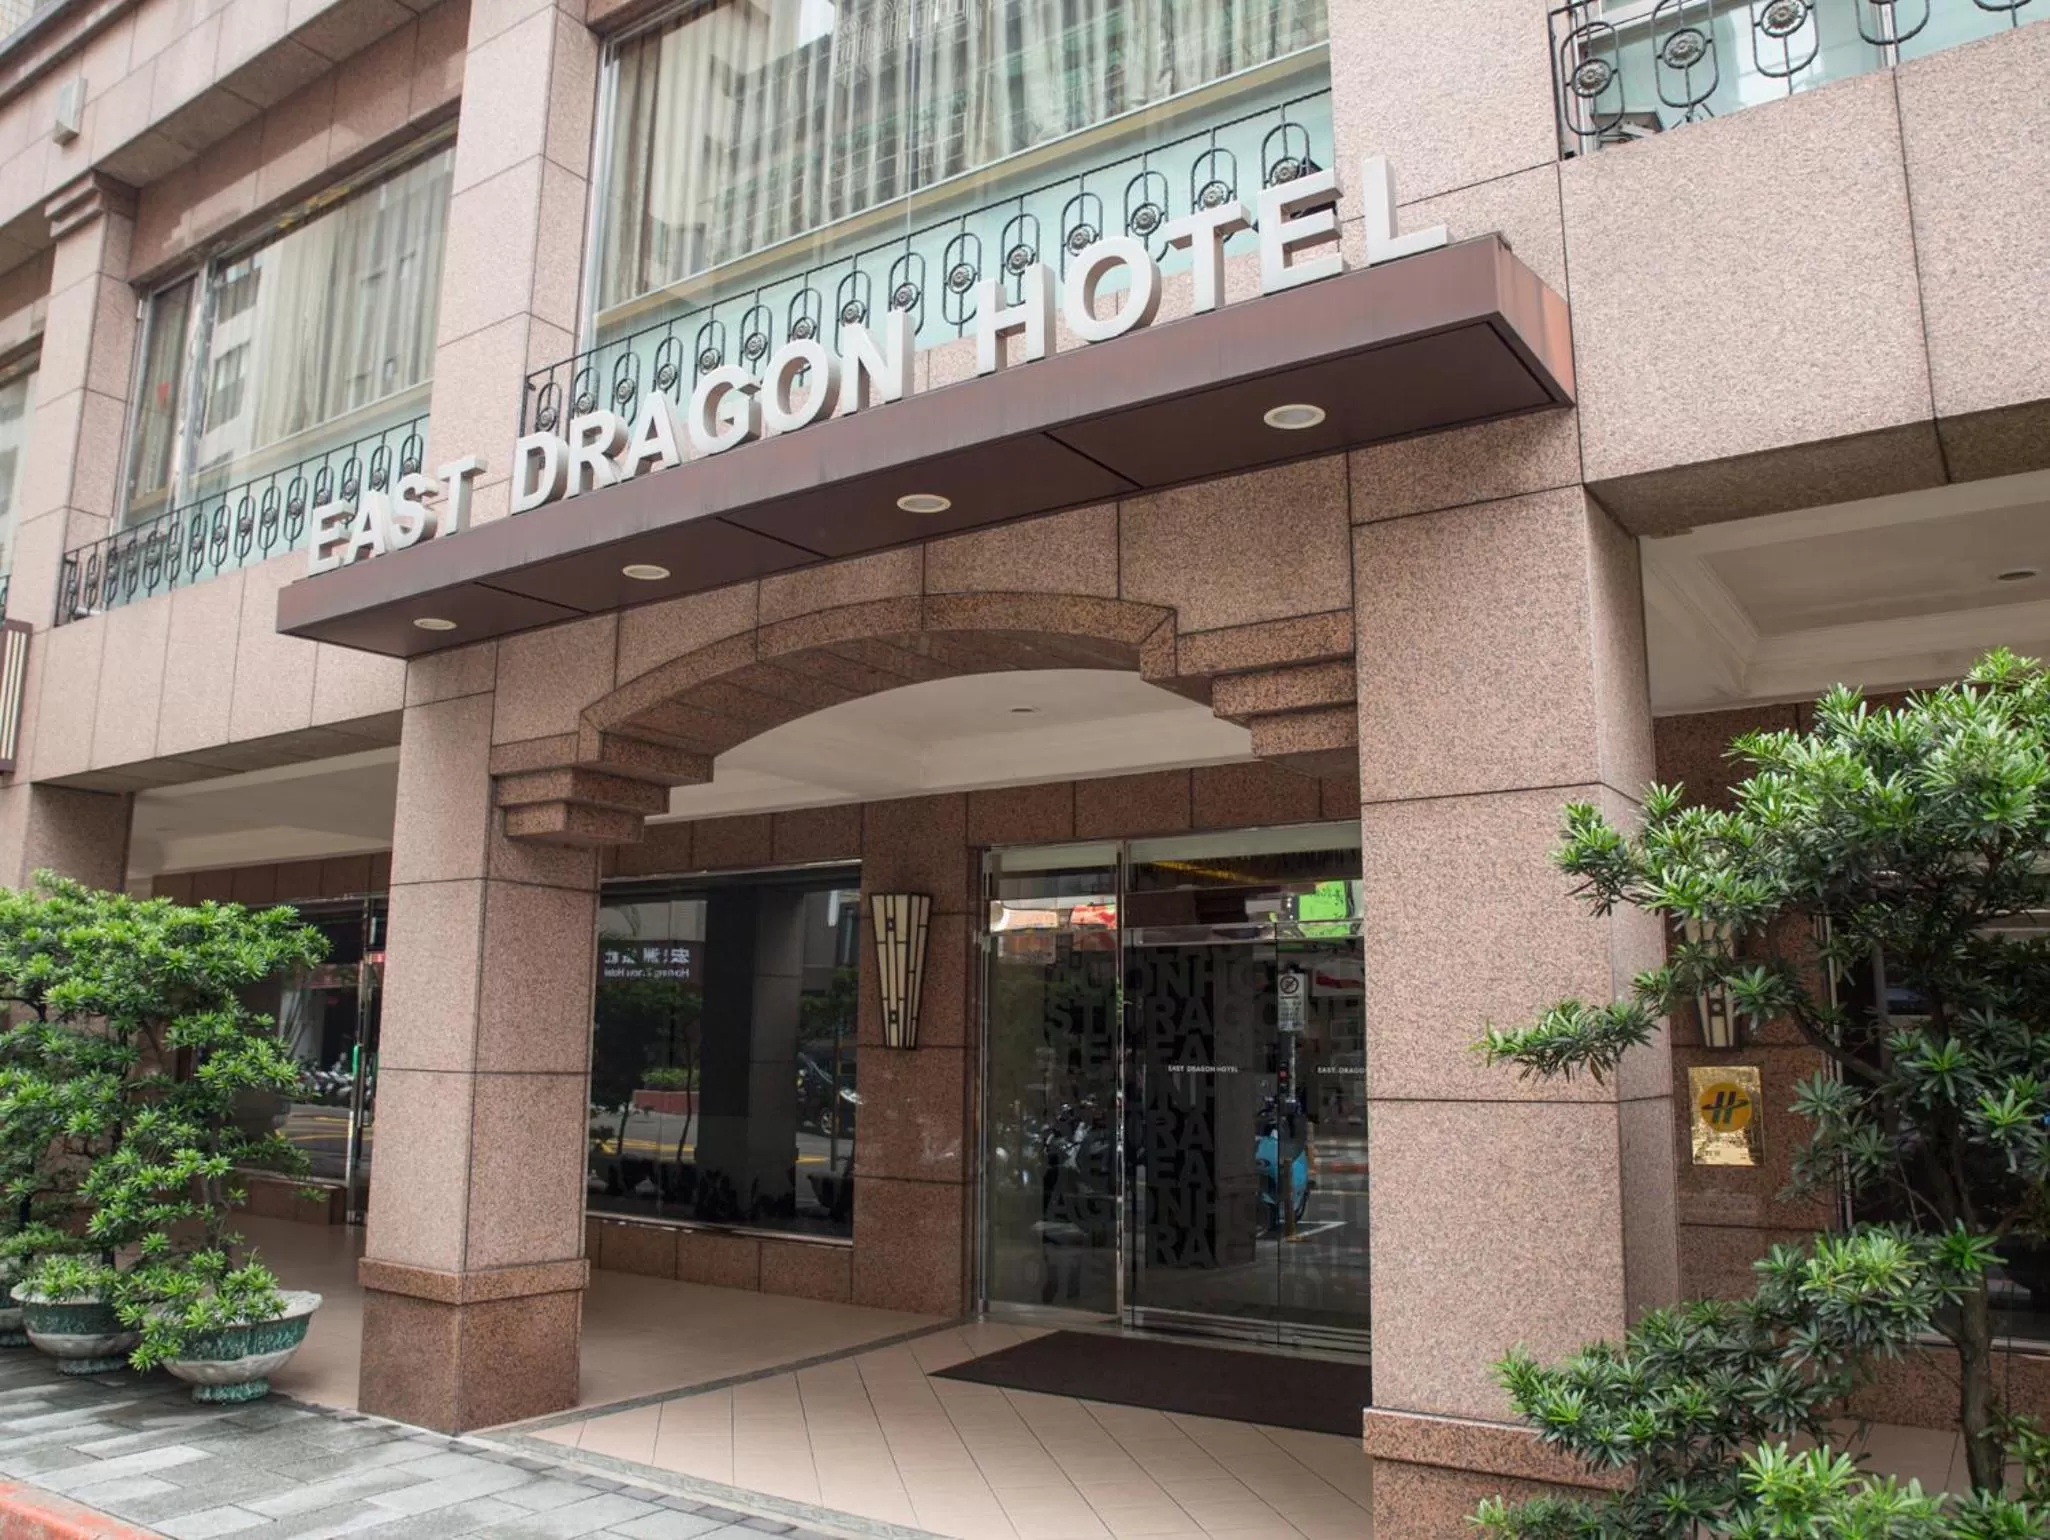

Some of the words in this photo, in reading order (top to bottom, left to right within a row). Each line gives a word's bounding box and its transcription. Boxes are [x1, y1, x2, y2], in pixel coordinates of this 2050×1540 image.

[308, 455, 488, 577] EAST
[511, 306, 917, 515] DRAGON
[975, 155, 1451, 378] HOTEL
[1168, 1065, 1184, 1073] EAST
[1186, 1065, 1215, 1073] DRAGON
[1317, 1066, 1336, 1074] EAST
[1338, 1066, 1365, 1074] DRAGO
